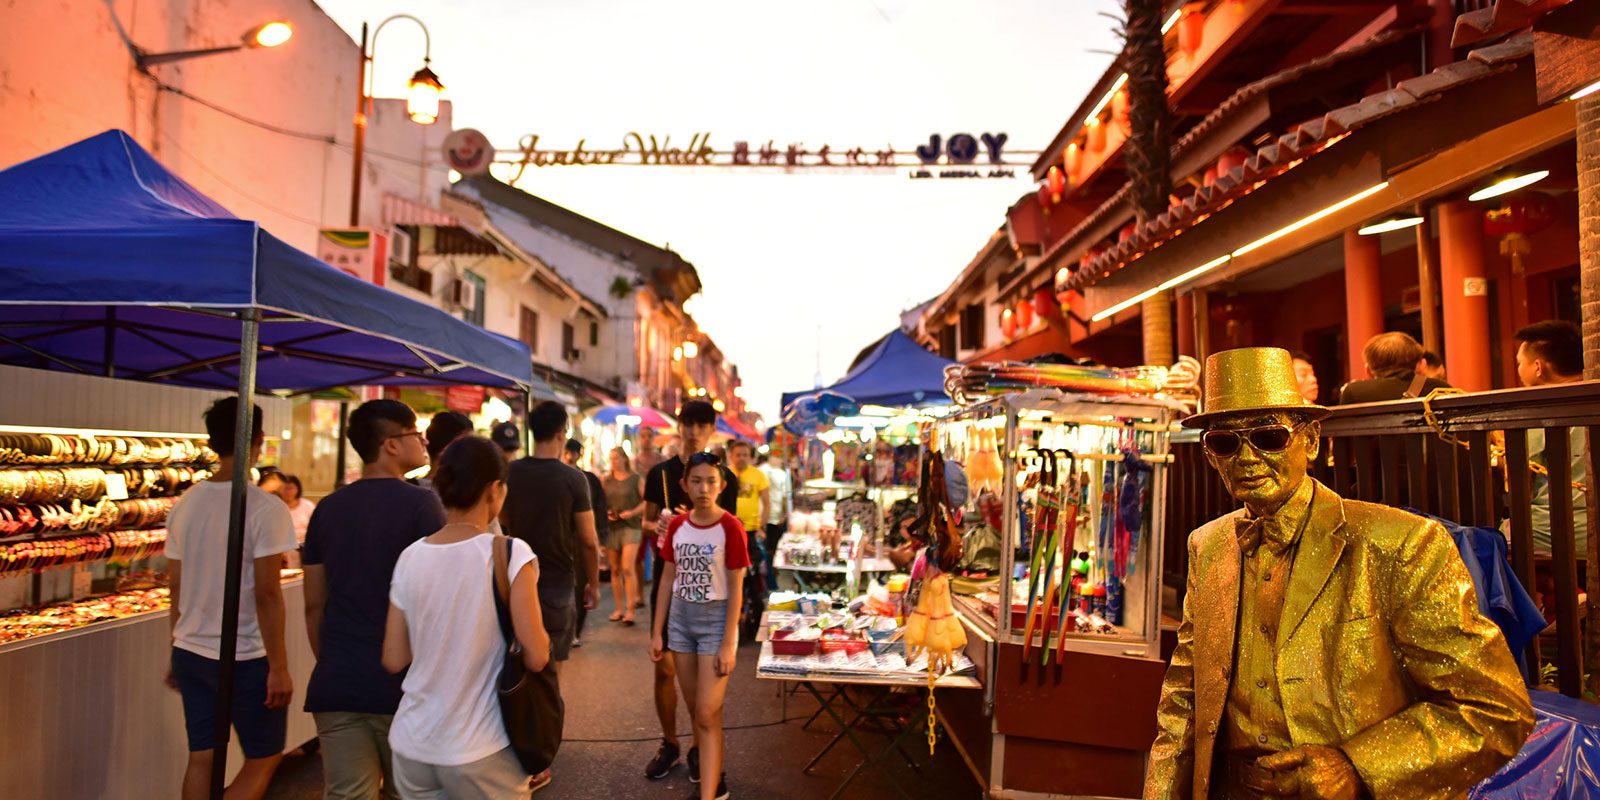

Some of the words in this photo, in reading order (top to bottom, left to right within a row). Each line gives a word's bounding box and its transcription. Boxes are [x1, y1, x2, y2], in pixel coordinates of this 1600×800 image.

[624, 131, 714, 165] Walk
[916, 133, 1008, 163] JOY
[680, 585, 711, 600] OUSE
